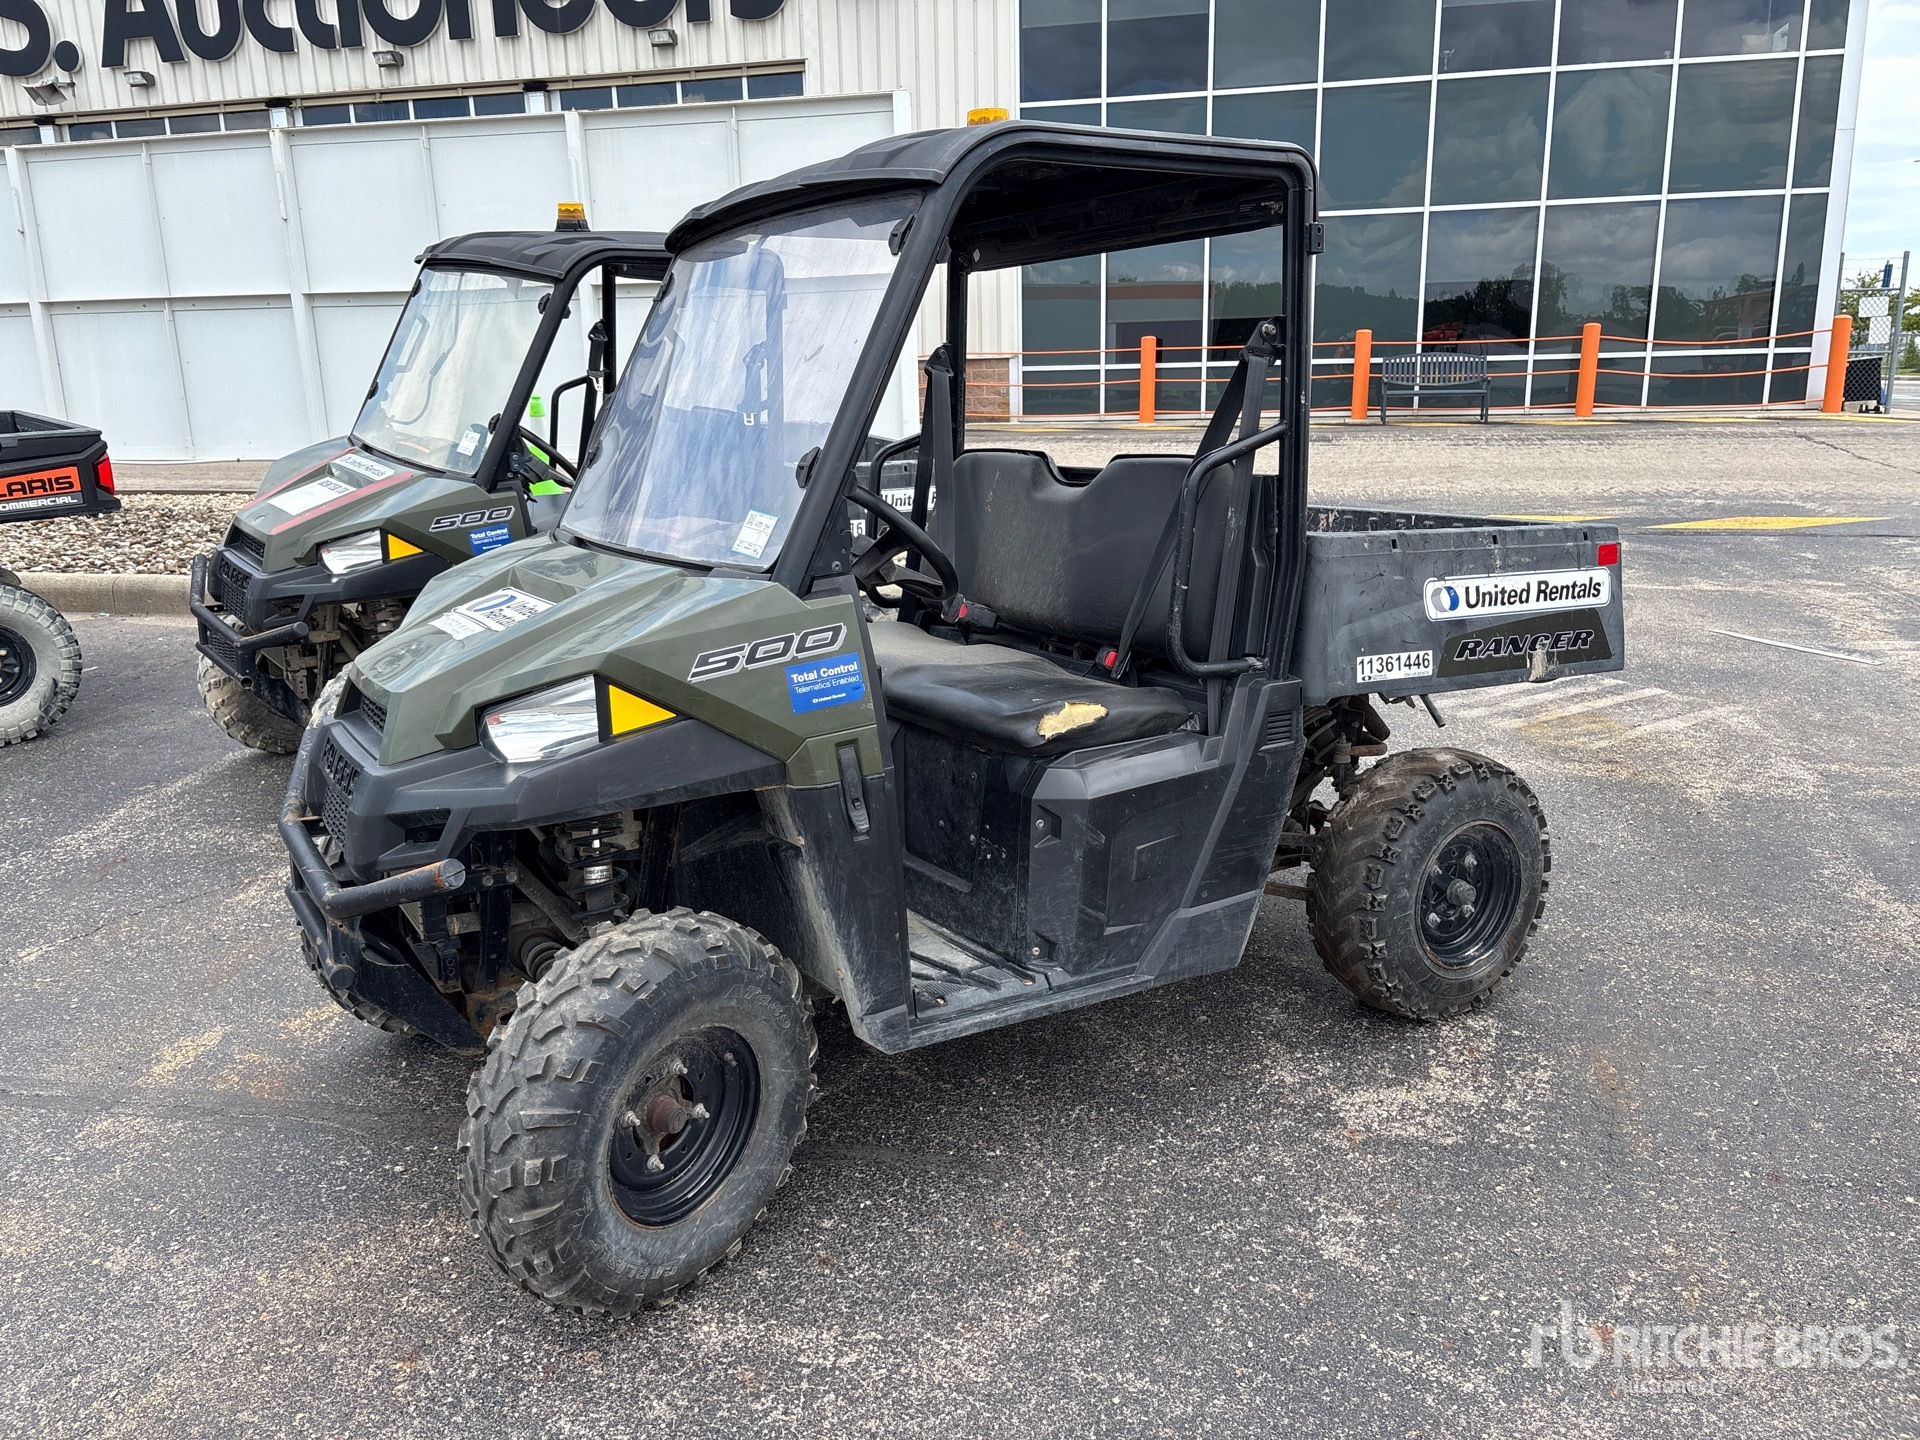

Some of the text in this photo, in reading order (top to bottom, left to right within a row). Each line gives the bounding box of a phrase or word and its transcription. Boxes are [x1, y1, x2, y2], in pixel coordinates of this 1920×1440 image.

[429, 505, 516, 533] 500
[470, 528, 508, 539] Total Control
[1464, 577, 1601, 609] United Rentals
[687, 622, 848, 683] 500
[1453, 629, 1595, 661] RANGER
[790, 661, 858, 684] Total Control
[1358, 653, 1430, 674] 11361446
[794, 674, 860, 695] Telematics Enabled
[321, 736, 362, 798] POLARIS
